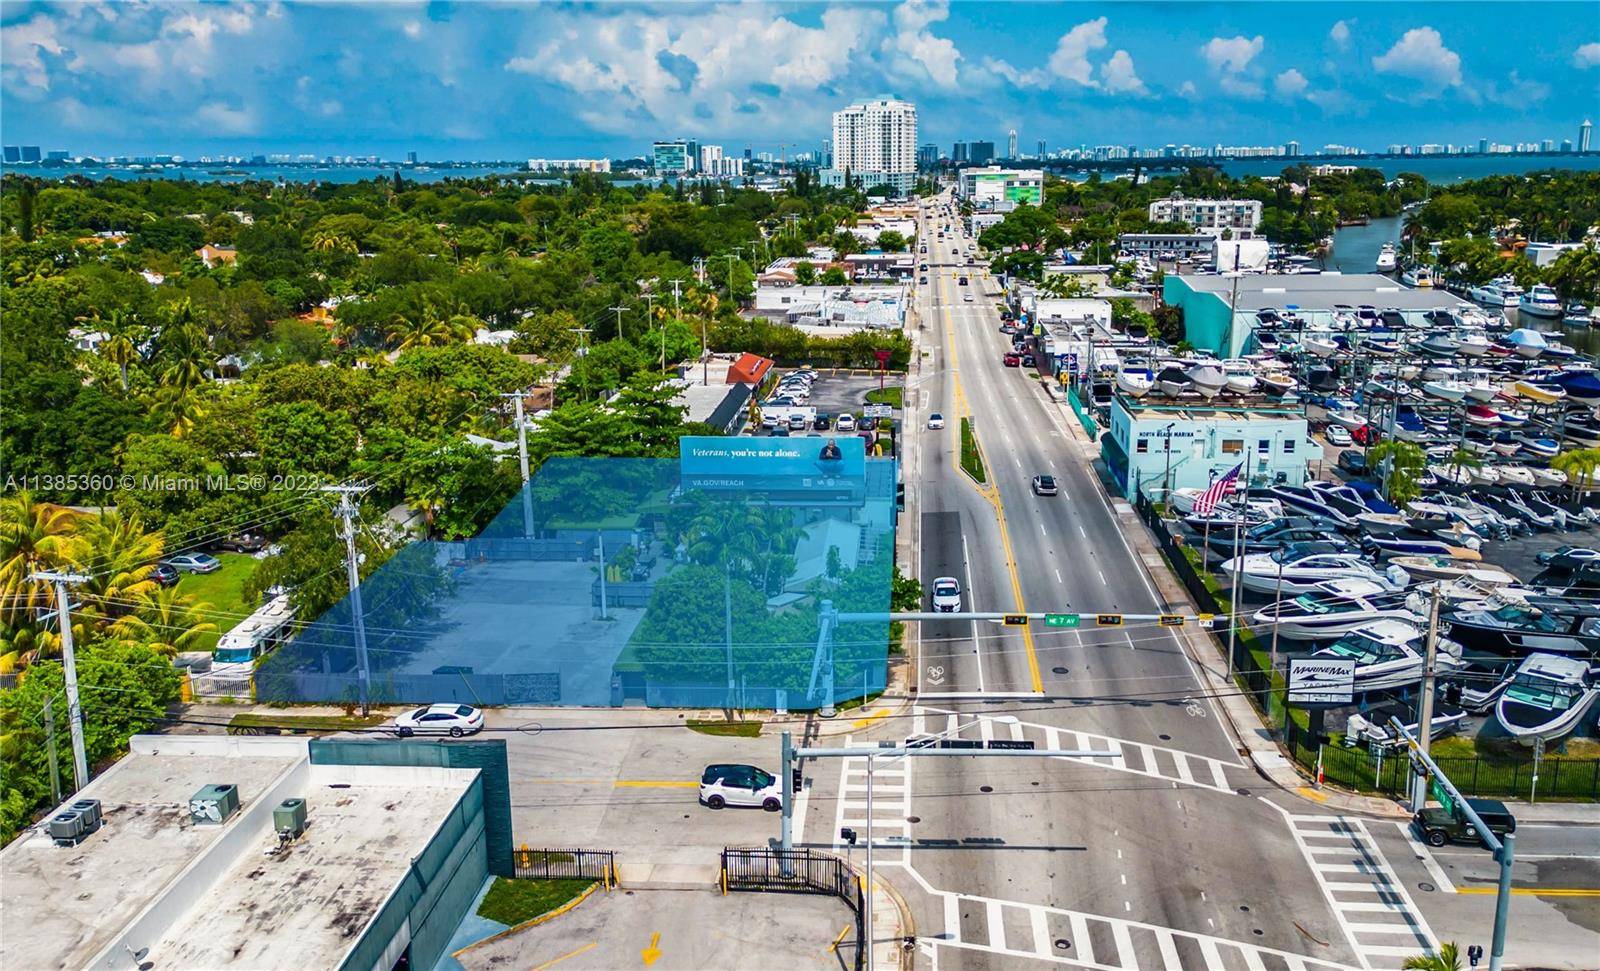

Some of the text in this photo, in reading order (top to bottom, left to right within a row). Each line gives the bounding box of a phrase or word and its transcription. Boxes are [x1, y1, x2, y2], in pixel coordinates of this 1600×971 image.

[692, 448, 801, 459] Veterans, you're not alone.
